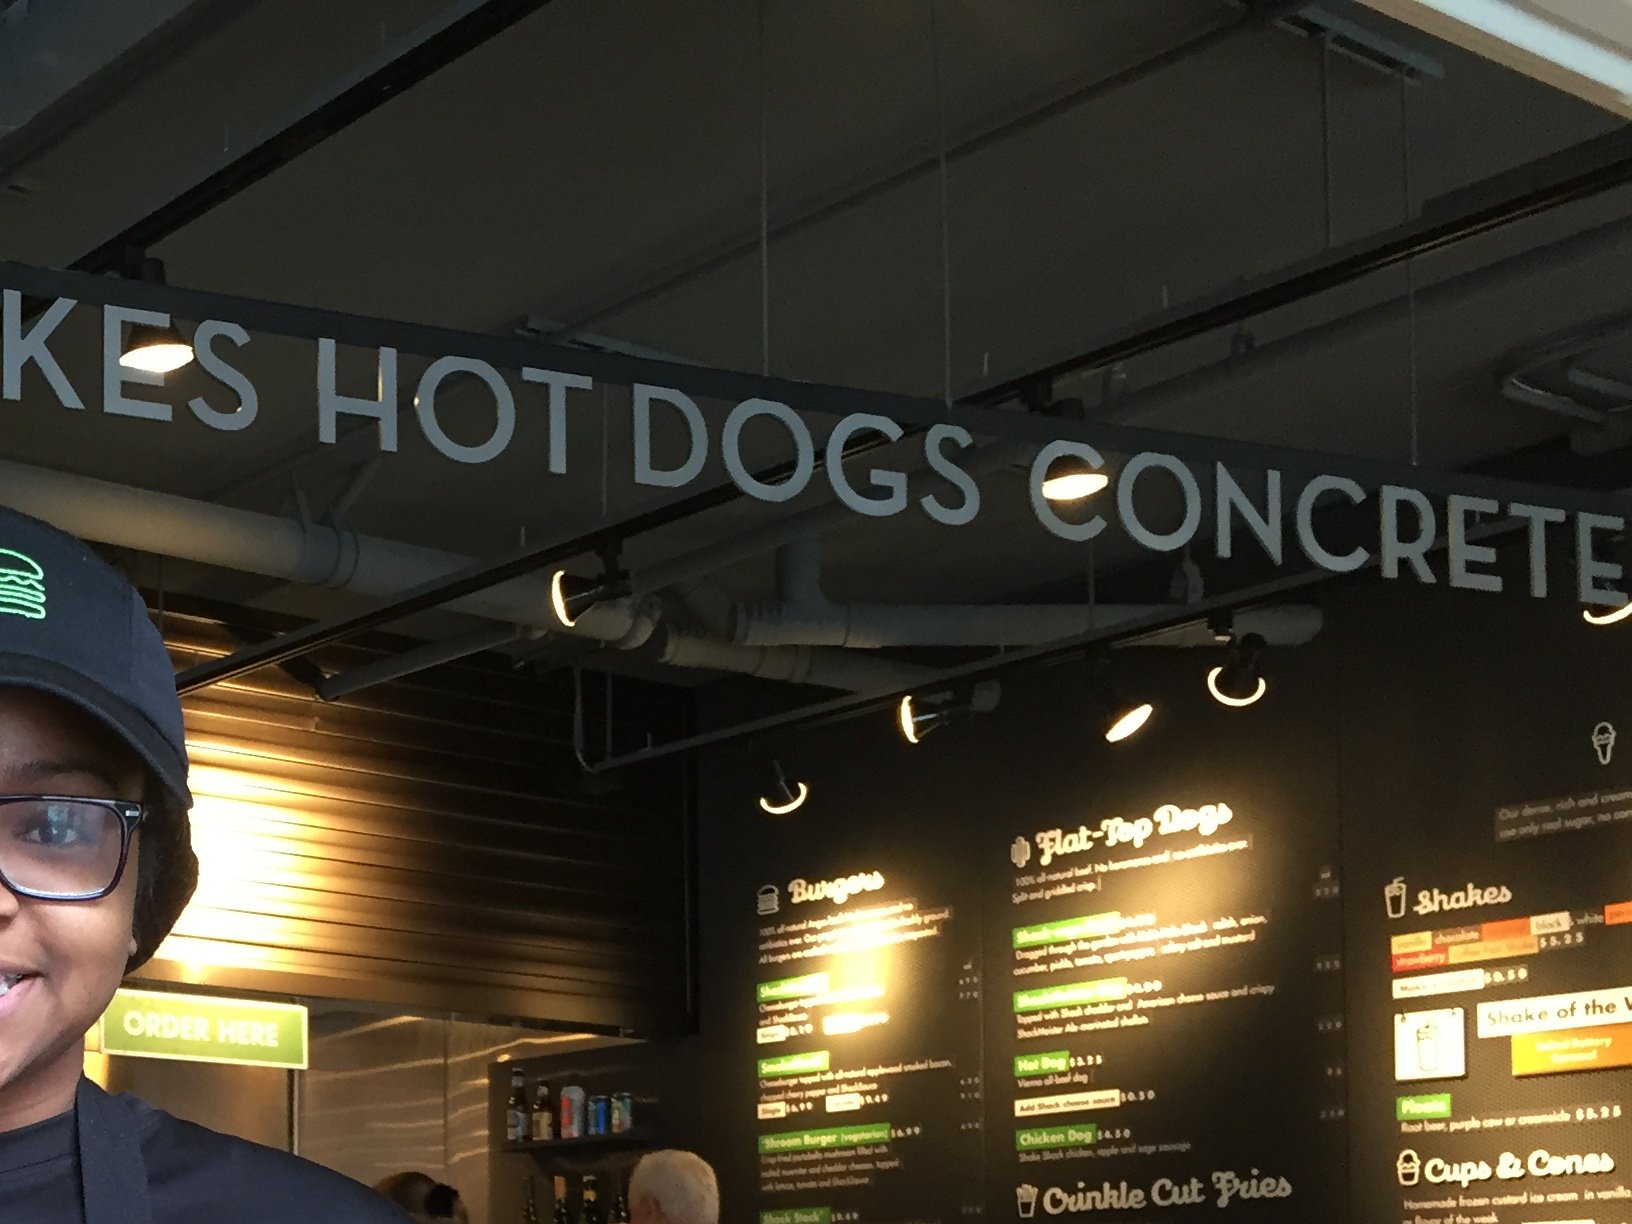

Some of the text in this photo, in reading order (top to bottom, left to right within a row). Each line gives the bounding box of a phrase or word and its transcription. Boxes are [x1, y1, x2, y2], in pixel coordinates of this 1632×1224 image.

[318, 337, 593, 474] HOT
[634, 383, 981, 526] DOGS
[1031, 440, 1632, 605] CONCRETE
[1035, 816, 1153, 866] Flat-Top
[788, 870, 885, 905] Burgers
[1413, 882, 1512, 915] Shakes
[124, 1010, 279, 1048] ORDER HERE
[1488, 999, 1616, 1026] Shake of the
[1018, 1056, 1067, 1073] Hot Dog
[803, 1132, 837, 1147] Burger
[1019, 1128, 1093, 1146] Chicken Dog
[1424, 1149, 1615, 1188] Cups & Cones
[1043, 1168, 1292, 1215] Crinkle Cut Fries
[1404, 1197, 1457, 1210] Homemade
[1458, 1194, 1490, 1207] frozen
[1491, 1191, 1528, 1206] custard
[1529, 1192, 1545, 1203] ice
[1546, 1190, 1578, 1202] cream
[1583, 1189, 1595, 1200] in
[1455, 1213, 1472, 1224] the
